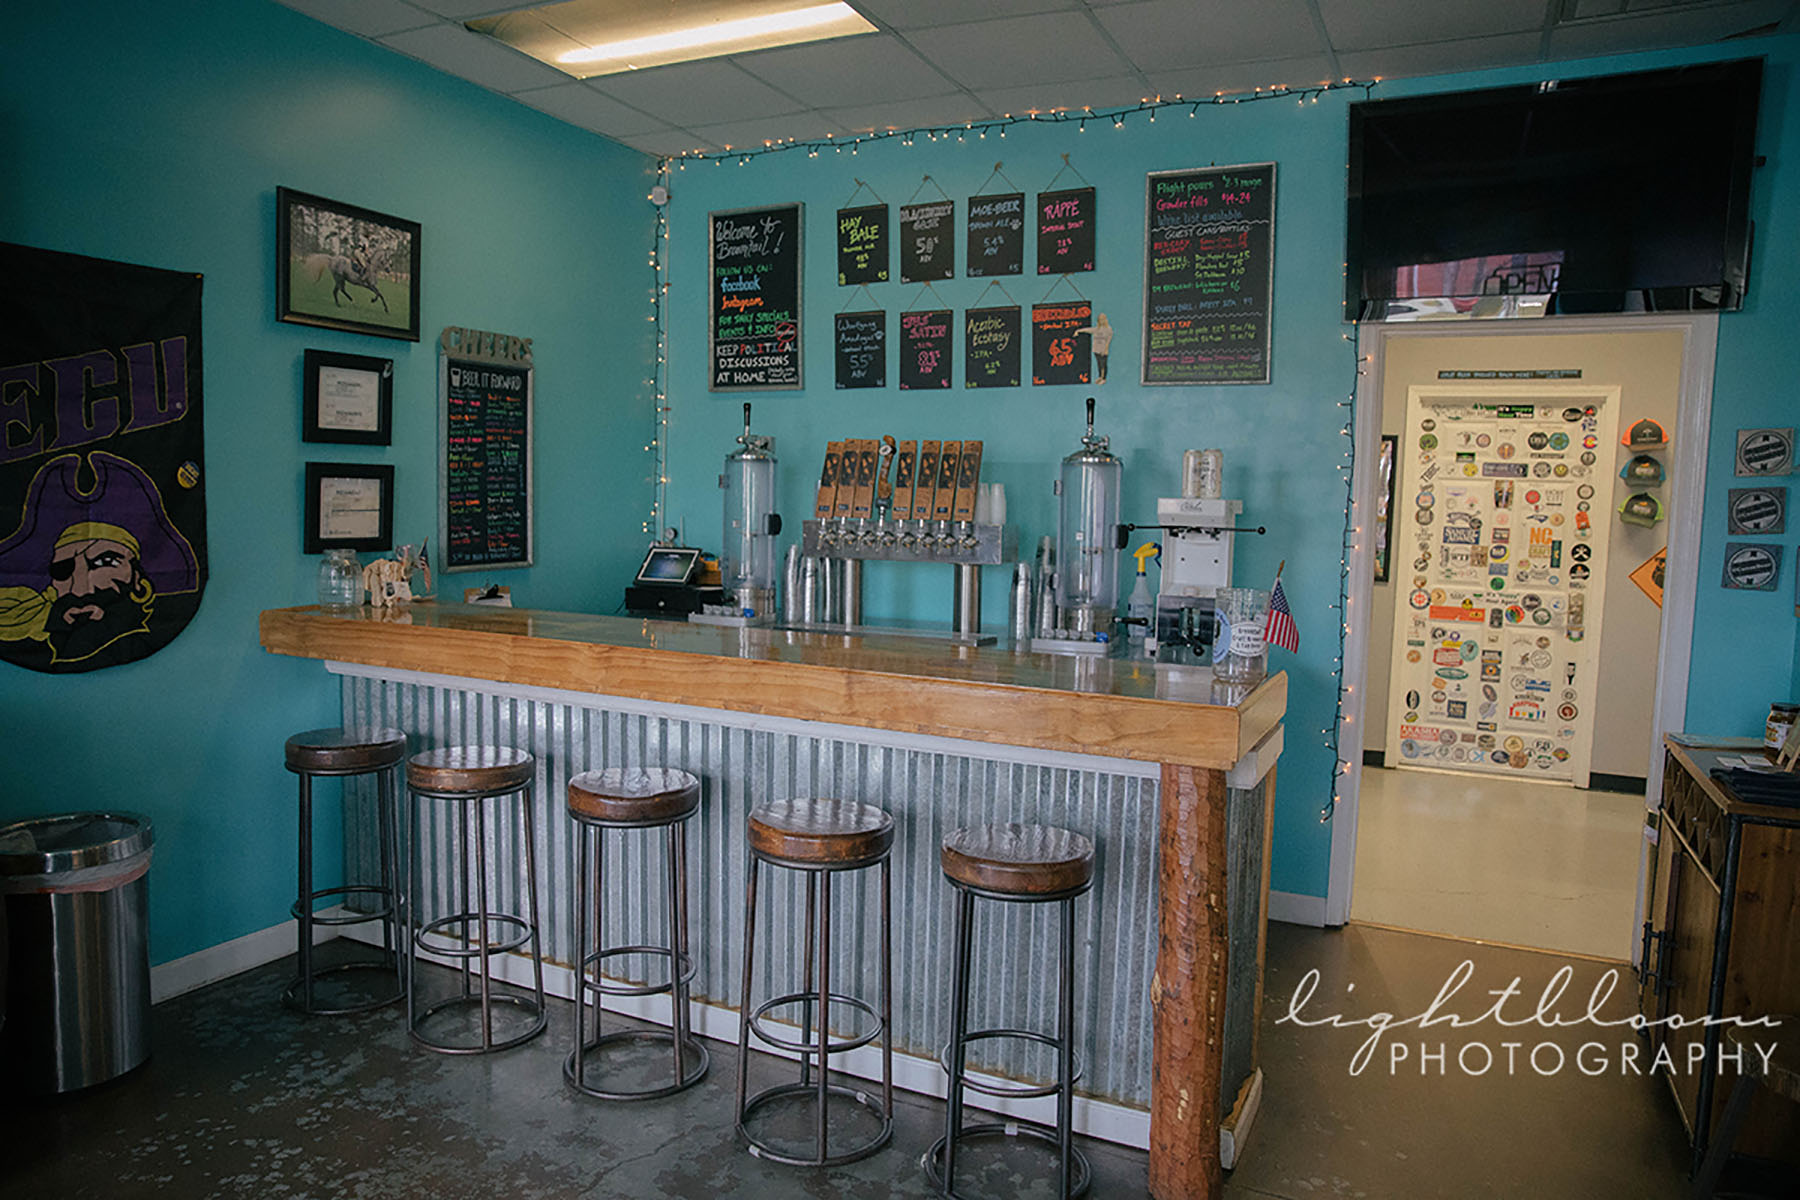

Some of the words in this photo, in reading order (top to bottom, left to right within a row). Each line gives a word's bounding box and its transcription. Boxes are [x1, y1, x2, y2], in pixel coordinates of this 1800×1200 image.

[1157, 181, 1186, 198] Flight
[1187, 181, 1214, 197] pours
[1190, 195, 1208, 208] fills
[716, 220, 759, 242] Welcome
[760, 216, 782, 235] to
[840, 215, 862, 234] HAY
[850, 225, 880, 244] BALE
[720, 274, 762, 293] facebook
[721, 294, 764, 312] Instagram
[441, 325, 534, 361] CHEERS
[717, 344, 740, 358] KEEP
[740, 342, 798, 356] POLITICAL
[719, 355, 790, 370] DISCUSSIONS
[716, 371, 731, 384] AT
[734, 370, 766, 384] HOME
[0, 335, 189, 464] ECU
[1529, 527, 1553, 546] NC
